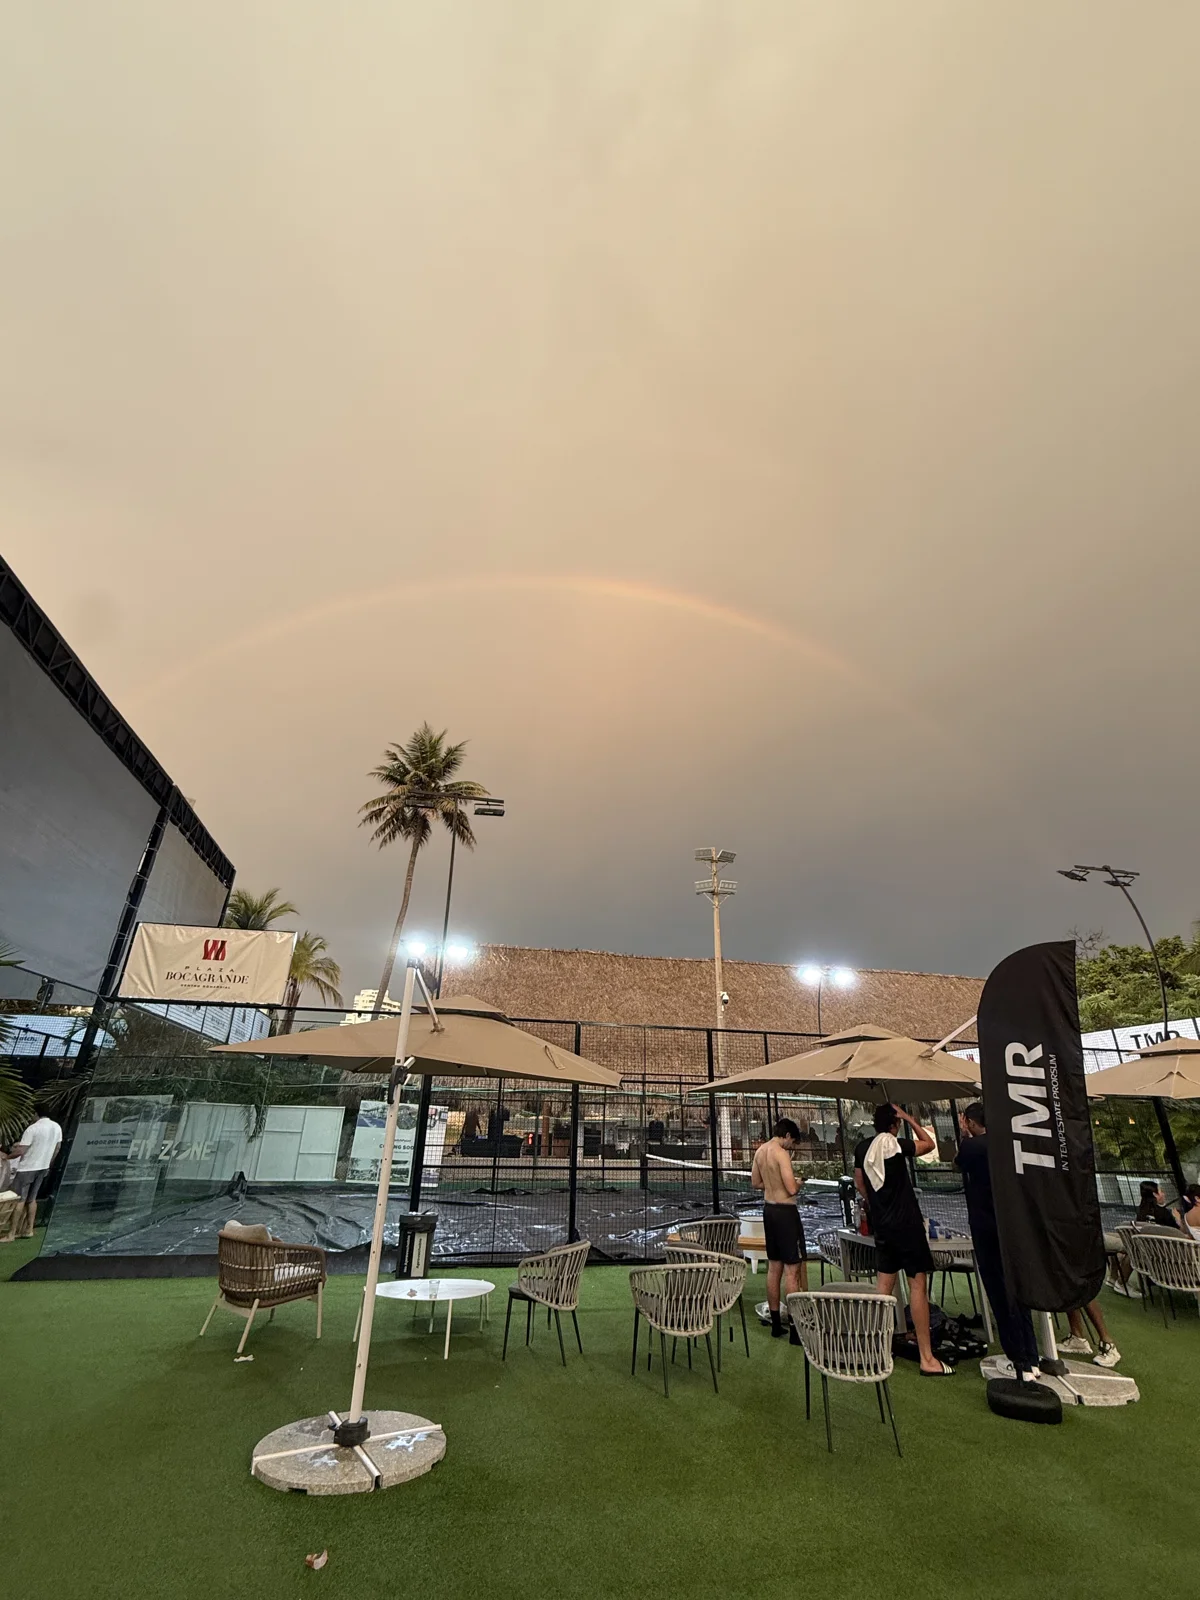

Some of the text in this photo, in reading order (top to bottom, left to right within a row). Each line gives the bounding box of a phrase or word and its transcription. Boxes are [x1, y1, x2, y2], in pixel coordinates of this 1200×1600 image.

[165, 971, 250, 985] BOCAGRANDE
[184, 965, 235, 973] PLAZA
[1004, 1041, 1056, 1175] TMR
[1048, 1054, 1070, 1171] IN TEMPESTATE PRORSUM
[127, 1139, 215, 1160] FIT ZONE
